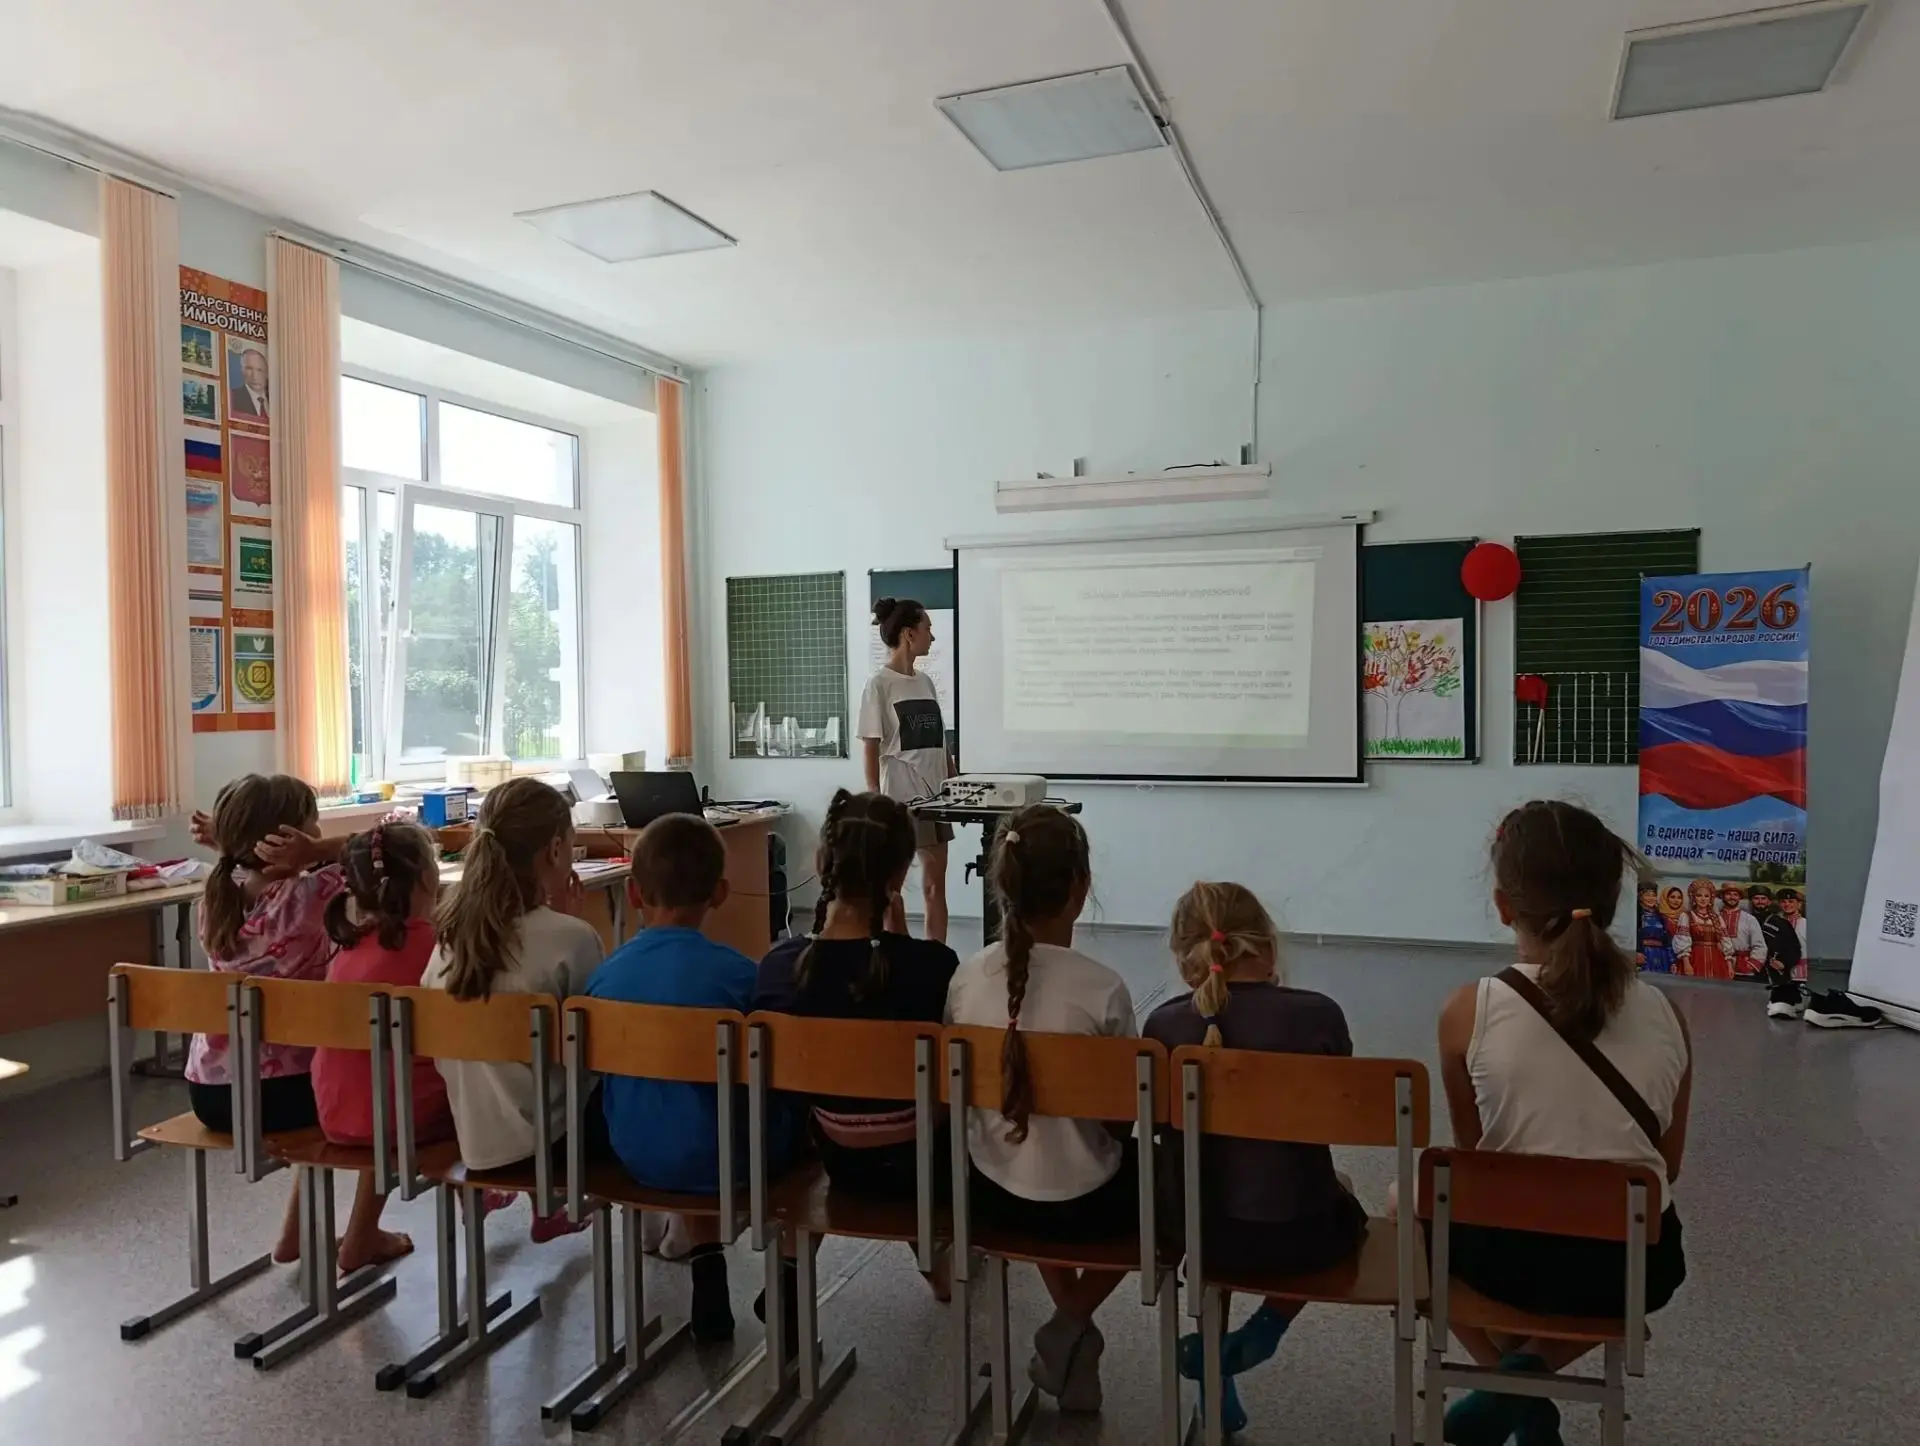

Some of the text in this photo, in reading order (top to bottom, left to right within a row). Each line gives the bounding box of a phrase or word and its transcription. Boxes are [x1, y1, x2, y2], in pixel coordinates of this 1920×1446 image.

[180, 289, 268, 323] УДАРСТВЕННА
[180, 304, 266, 339] ИМВОЛИКА
[1651, 583, 1800, 632] 2026
[1648, 632, 1799, 647] ГОД ЕДИНСТВА НАРОДОВ РОССИИ!
[1647, 824, 1656, 838] В
[1658, 826, 1715, 841] единстве
[1727, 829, 1760, 843] наша
[1763, 831, 1799, 845] сила,
[1644, 844, 1652, 856] в
[1655, 845, 1704, 860] сердцах
[1717, 849, 1747, 862] одна
